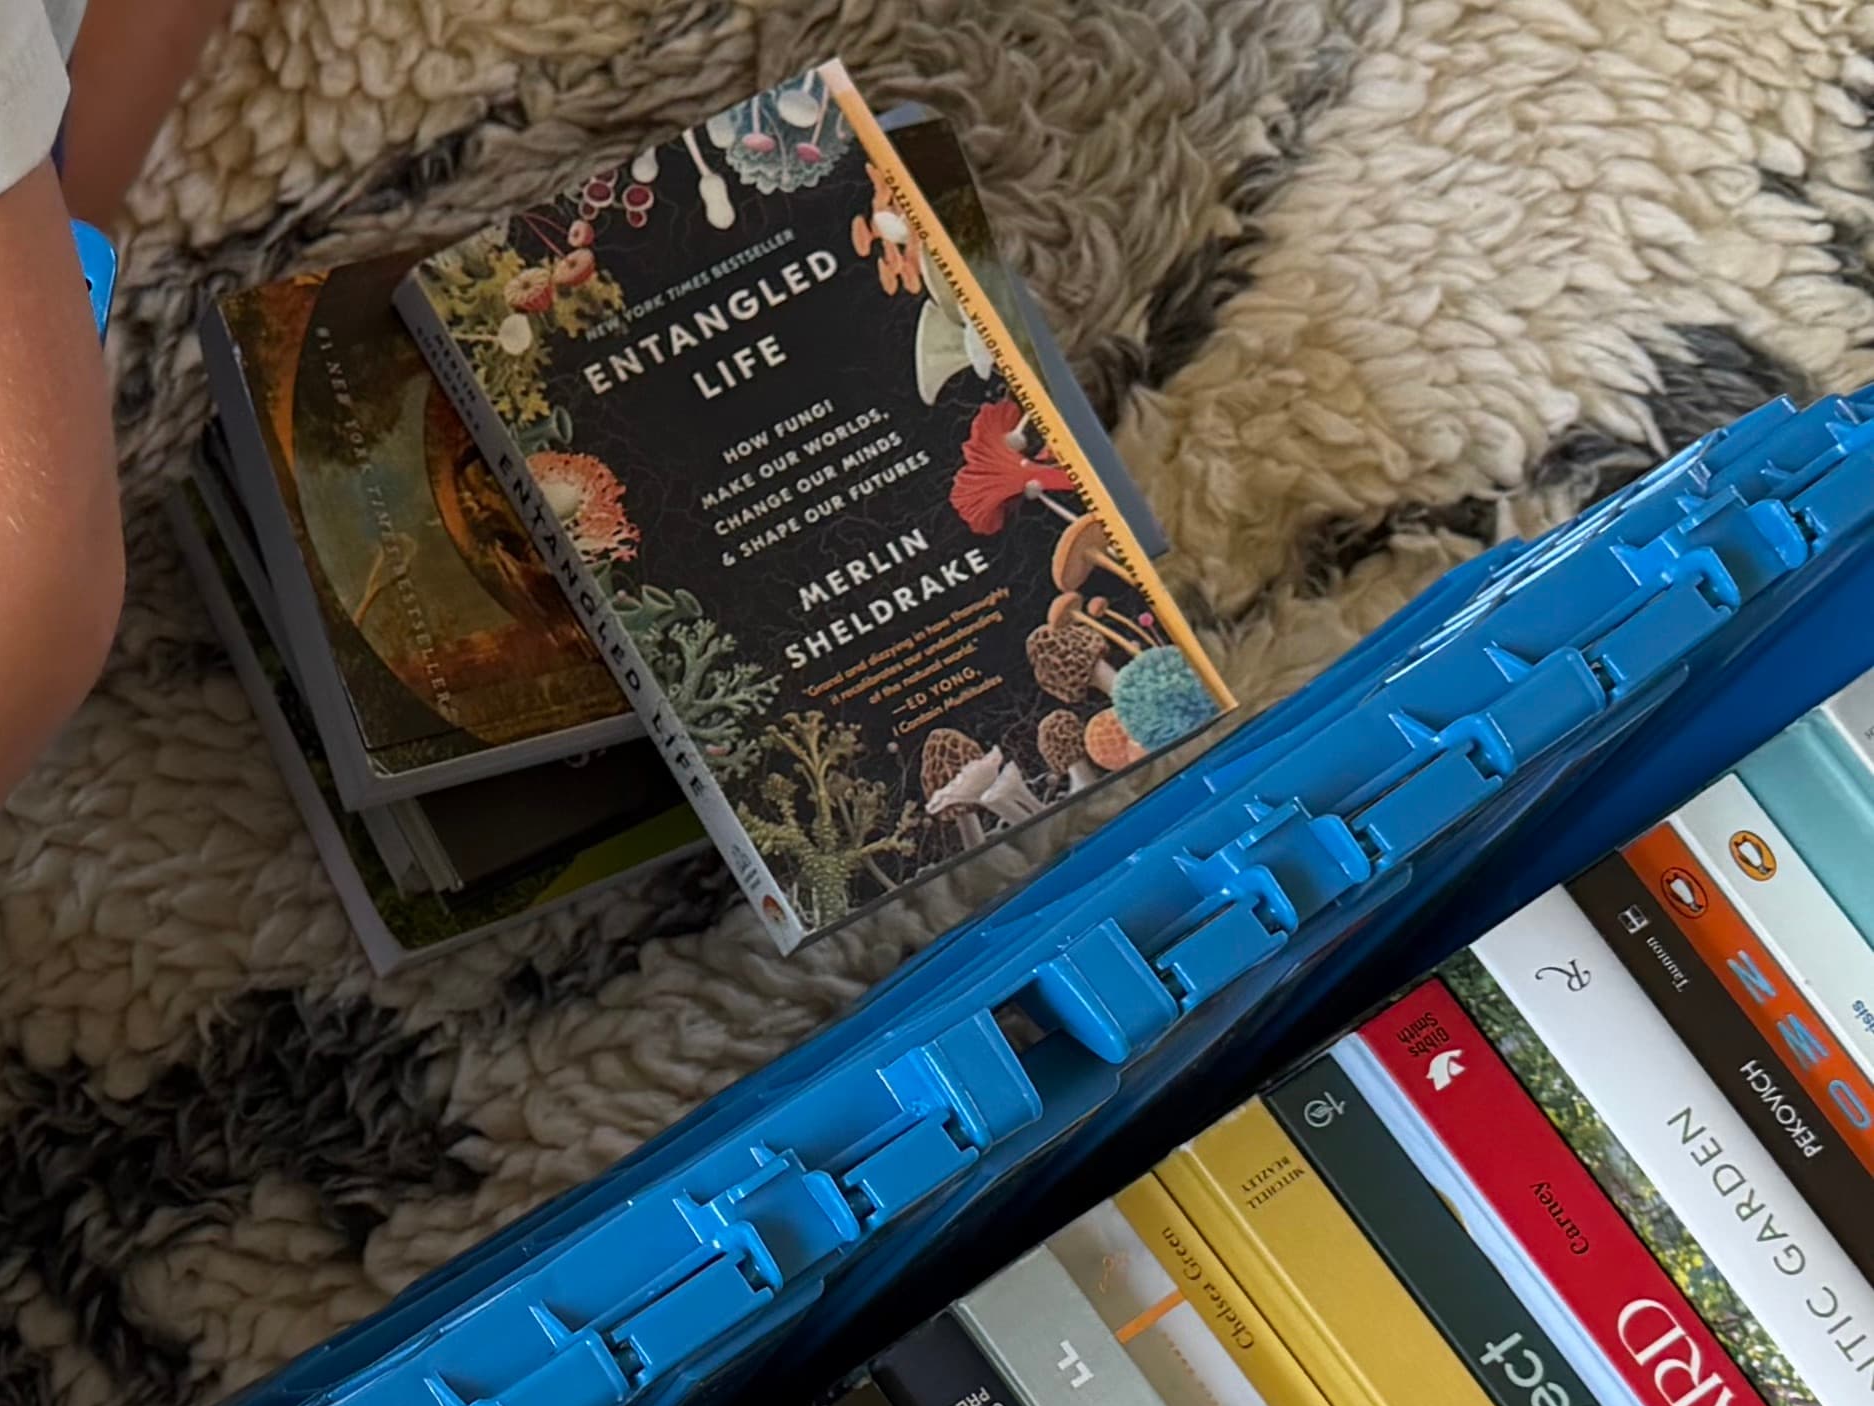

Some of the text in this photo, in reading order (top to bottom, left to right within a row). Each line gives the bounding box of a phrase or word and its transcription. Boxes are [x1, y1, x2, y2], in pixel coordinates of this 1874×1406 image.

[584, 251, 837, 394] ENTANGLED
[693, 335, 786, 398] LIFE
[702, 408, 889, 509] MAKE OUR WORLDS,
[723, 399, 833, 463] HOW FUNGI
[715, 431, 902, 535] CHANGE OUR MINDS
[740, 450, 930, 557] SHAPE OUR FUTURES
[785, 548, 989, 668] SHELDRAKE
[799, 528, 929, 611] MERLIN
[1739, 1059, 1822, 1156] PEKOVICH
[1530, 1181, 1589, 1253] Carney
[1667, 1106, 1805, 1274] GARDEN
[1161, 1225, 1254, 1348] Chelsea Green
